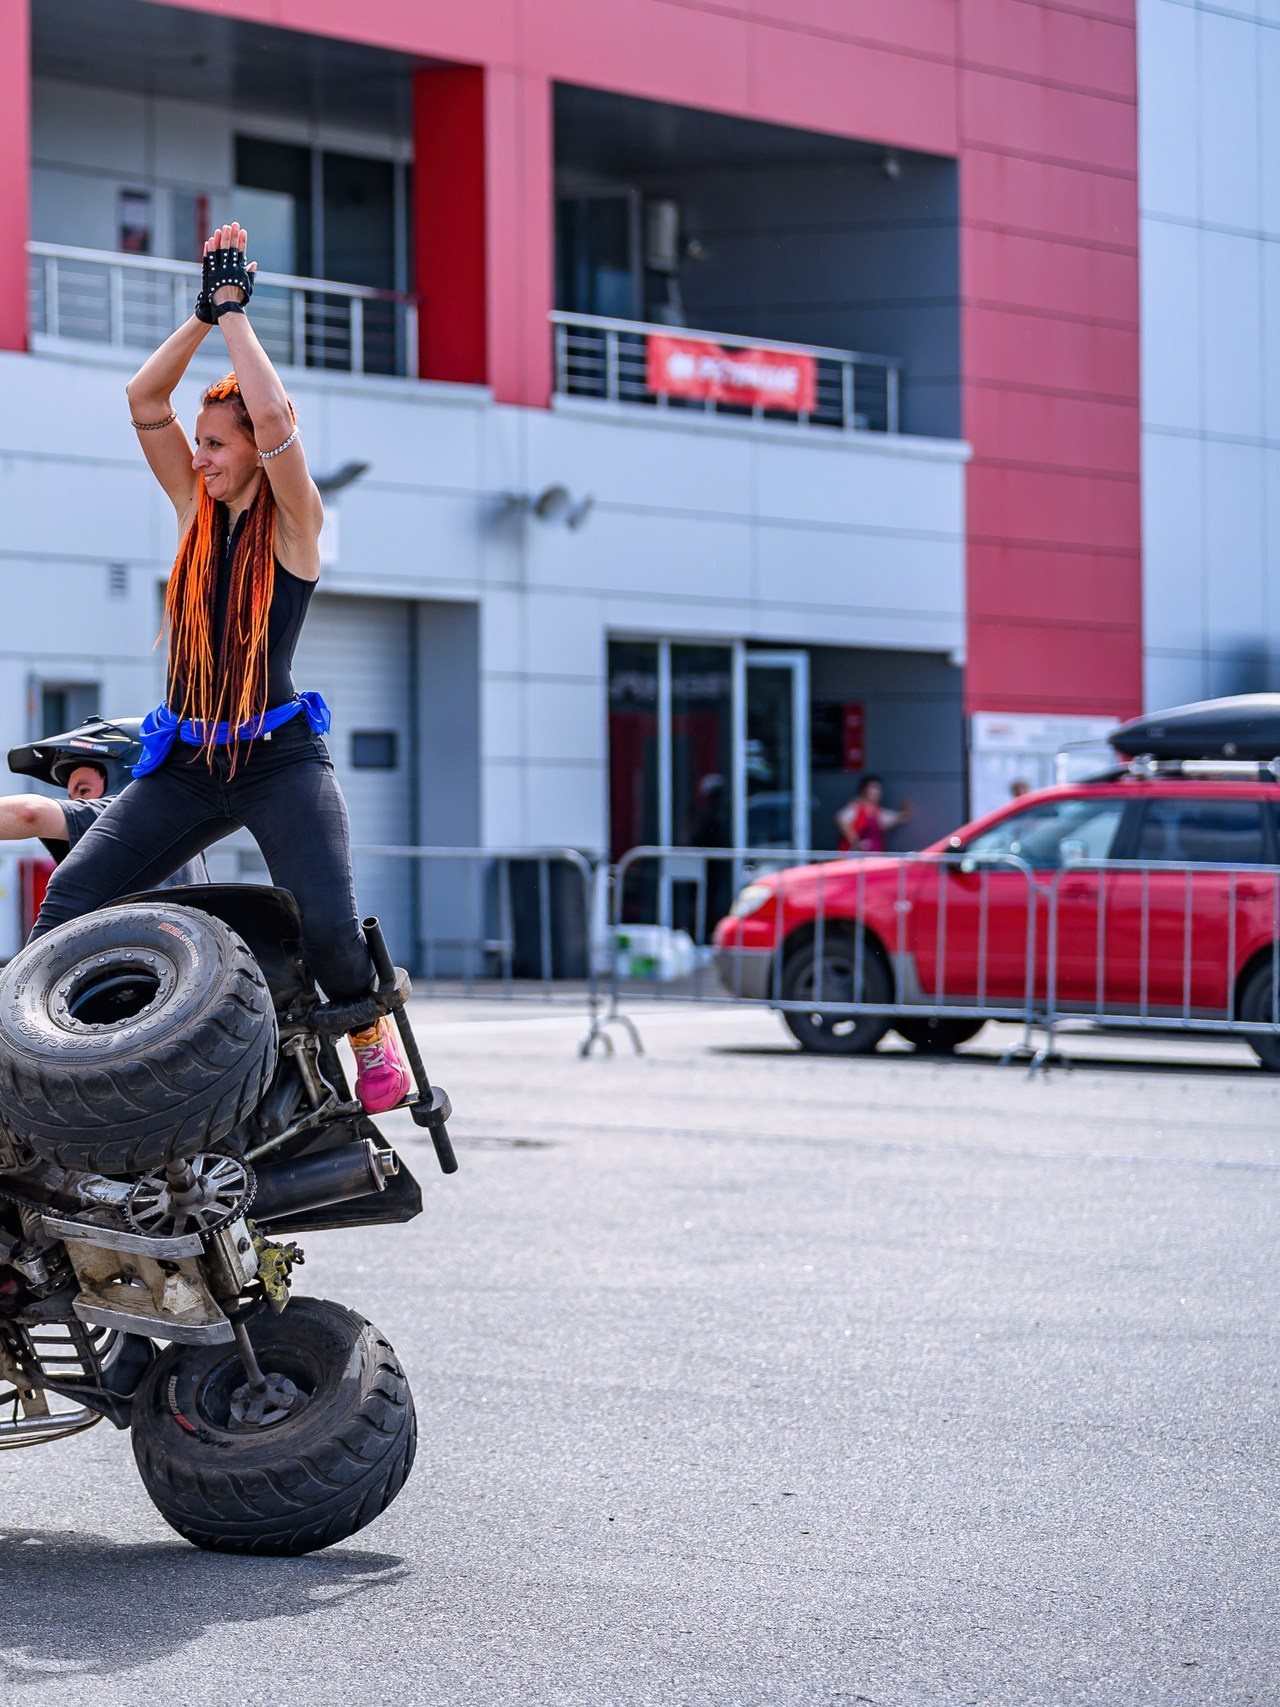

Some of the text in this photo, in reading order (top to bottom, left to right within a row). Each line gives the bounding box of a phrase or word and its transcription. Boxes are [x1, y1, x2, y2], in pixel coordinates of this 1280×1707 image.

[179, 934, 199, 969] SPEEDRACER
[18, 1019, 117, 1050] SPEEDRACER
[167, 1375, 181, 1415] SPEEDRACER
